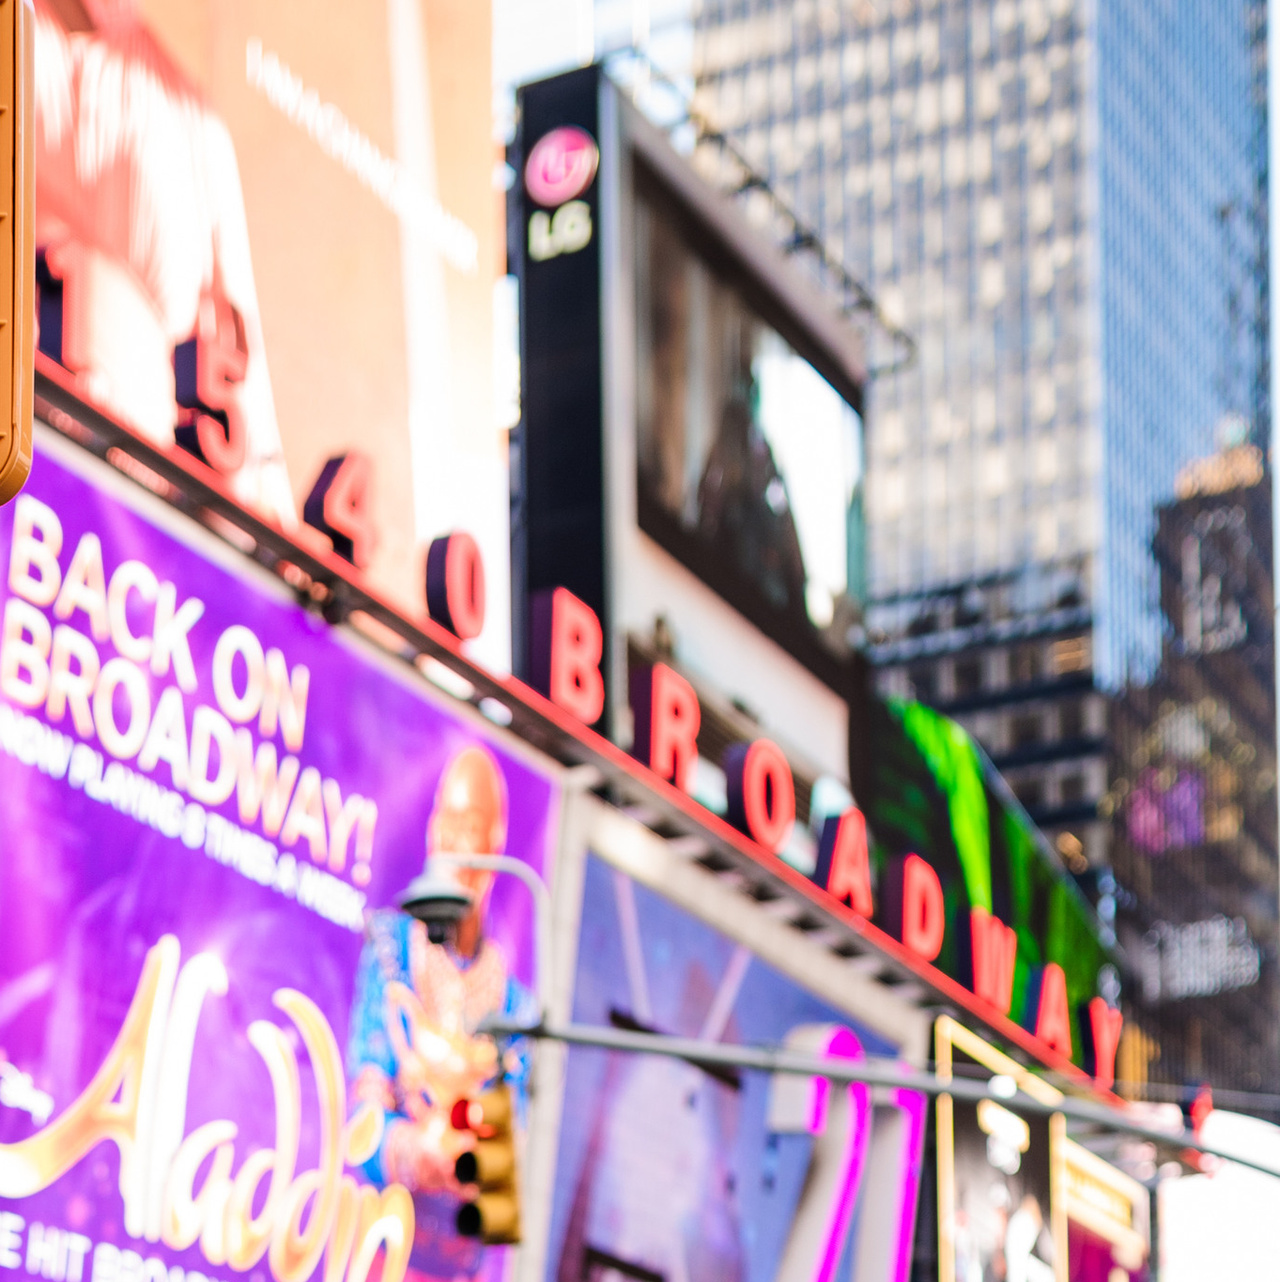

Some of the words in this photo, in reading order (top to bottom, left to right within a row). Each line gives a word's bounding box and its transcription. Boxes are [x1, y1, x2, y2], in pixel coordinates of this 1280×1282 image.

[528, 200, 593, 262] LG
[7, 492, 205, 692] BACK
[212, 623, 311, 752] ON
[45, 242, 487, 640] 1540
[550, 586, 1123, 1090] BROADWAY
